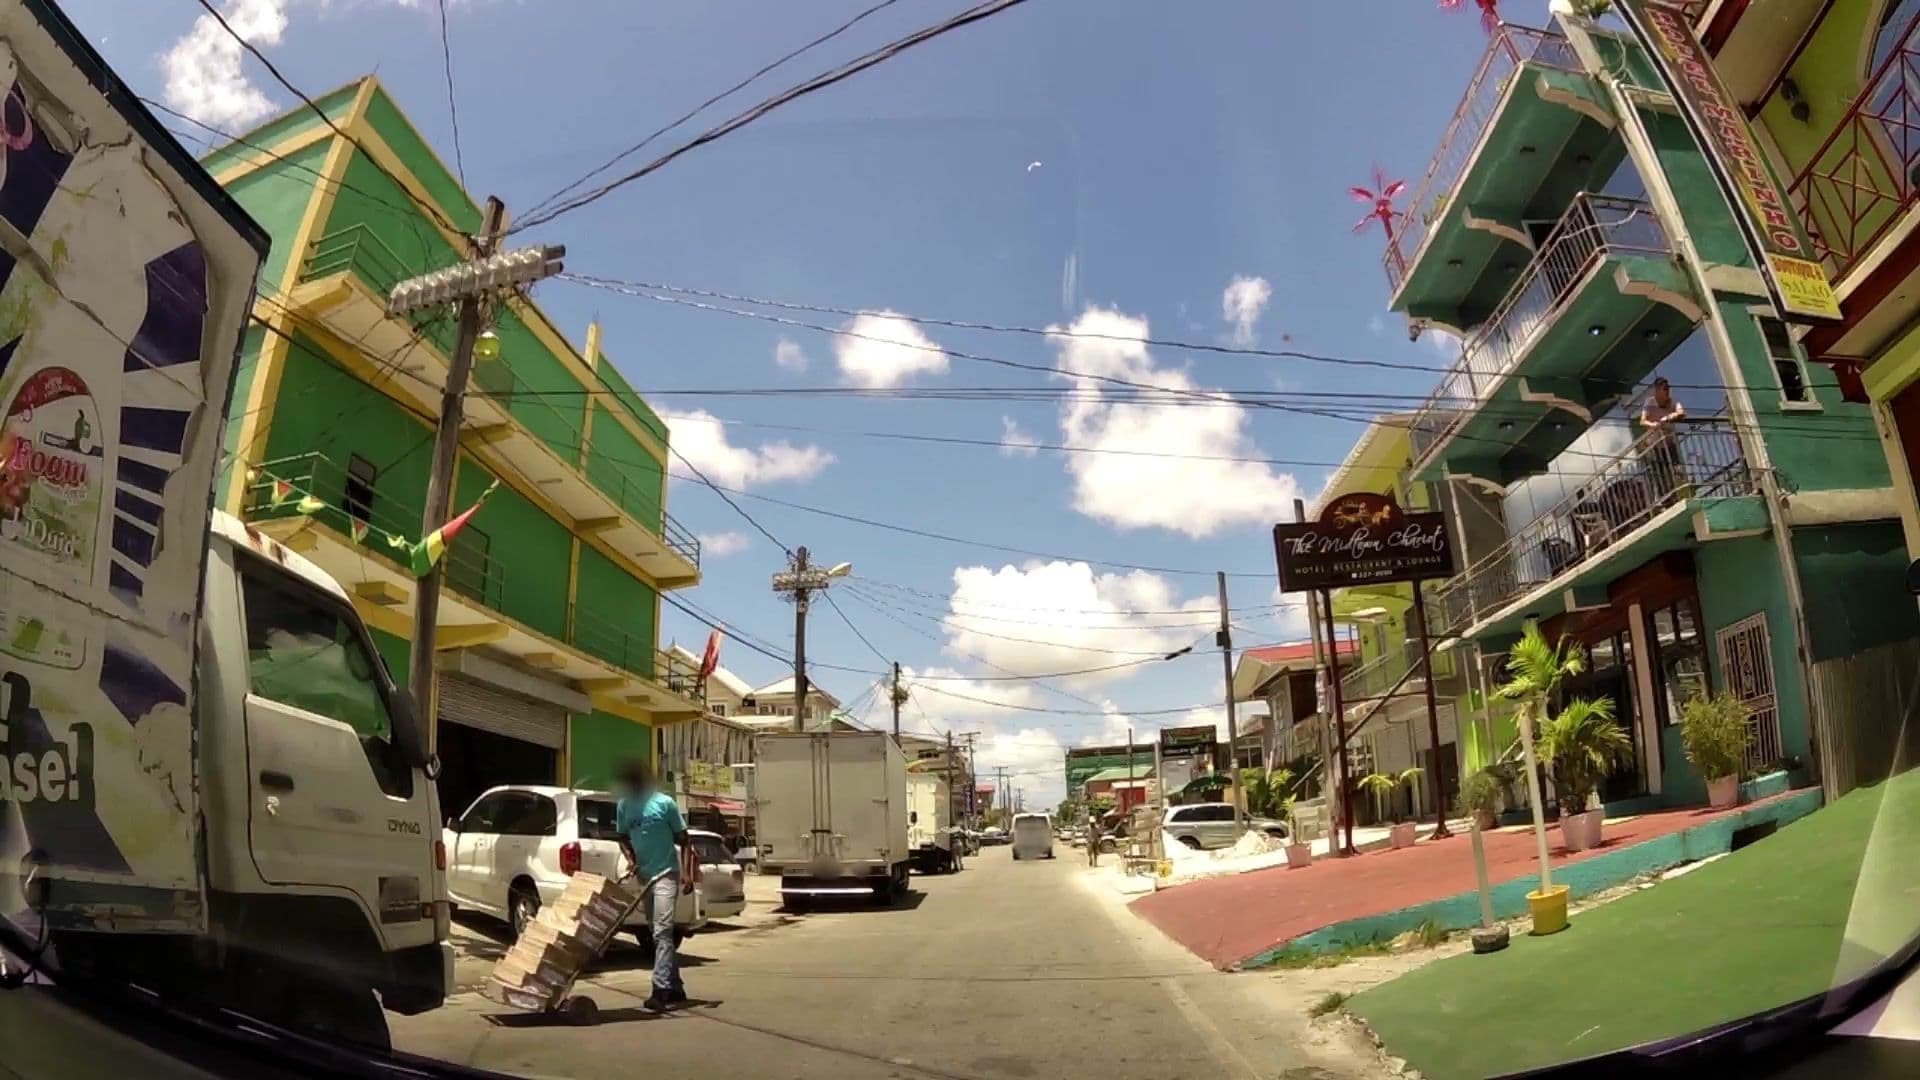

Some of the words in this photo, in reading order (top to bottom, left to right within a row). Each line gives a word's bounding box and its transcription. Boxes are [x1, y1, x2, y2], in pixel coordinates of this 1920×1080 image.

[1284, 531, 1318, 556] The
[1318, 527, 1384, 559] Midtown
[1387, 523, 1444, 551] Chariot
